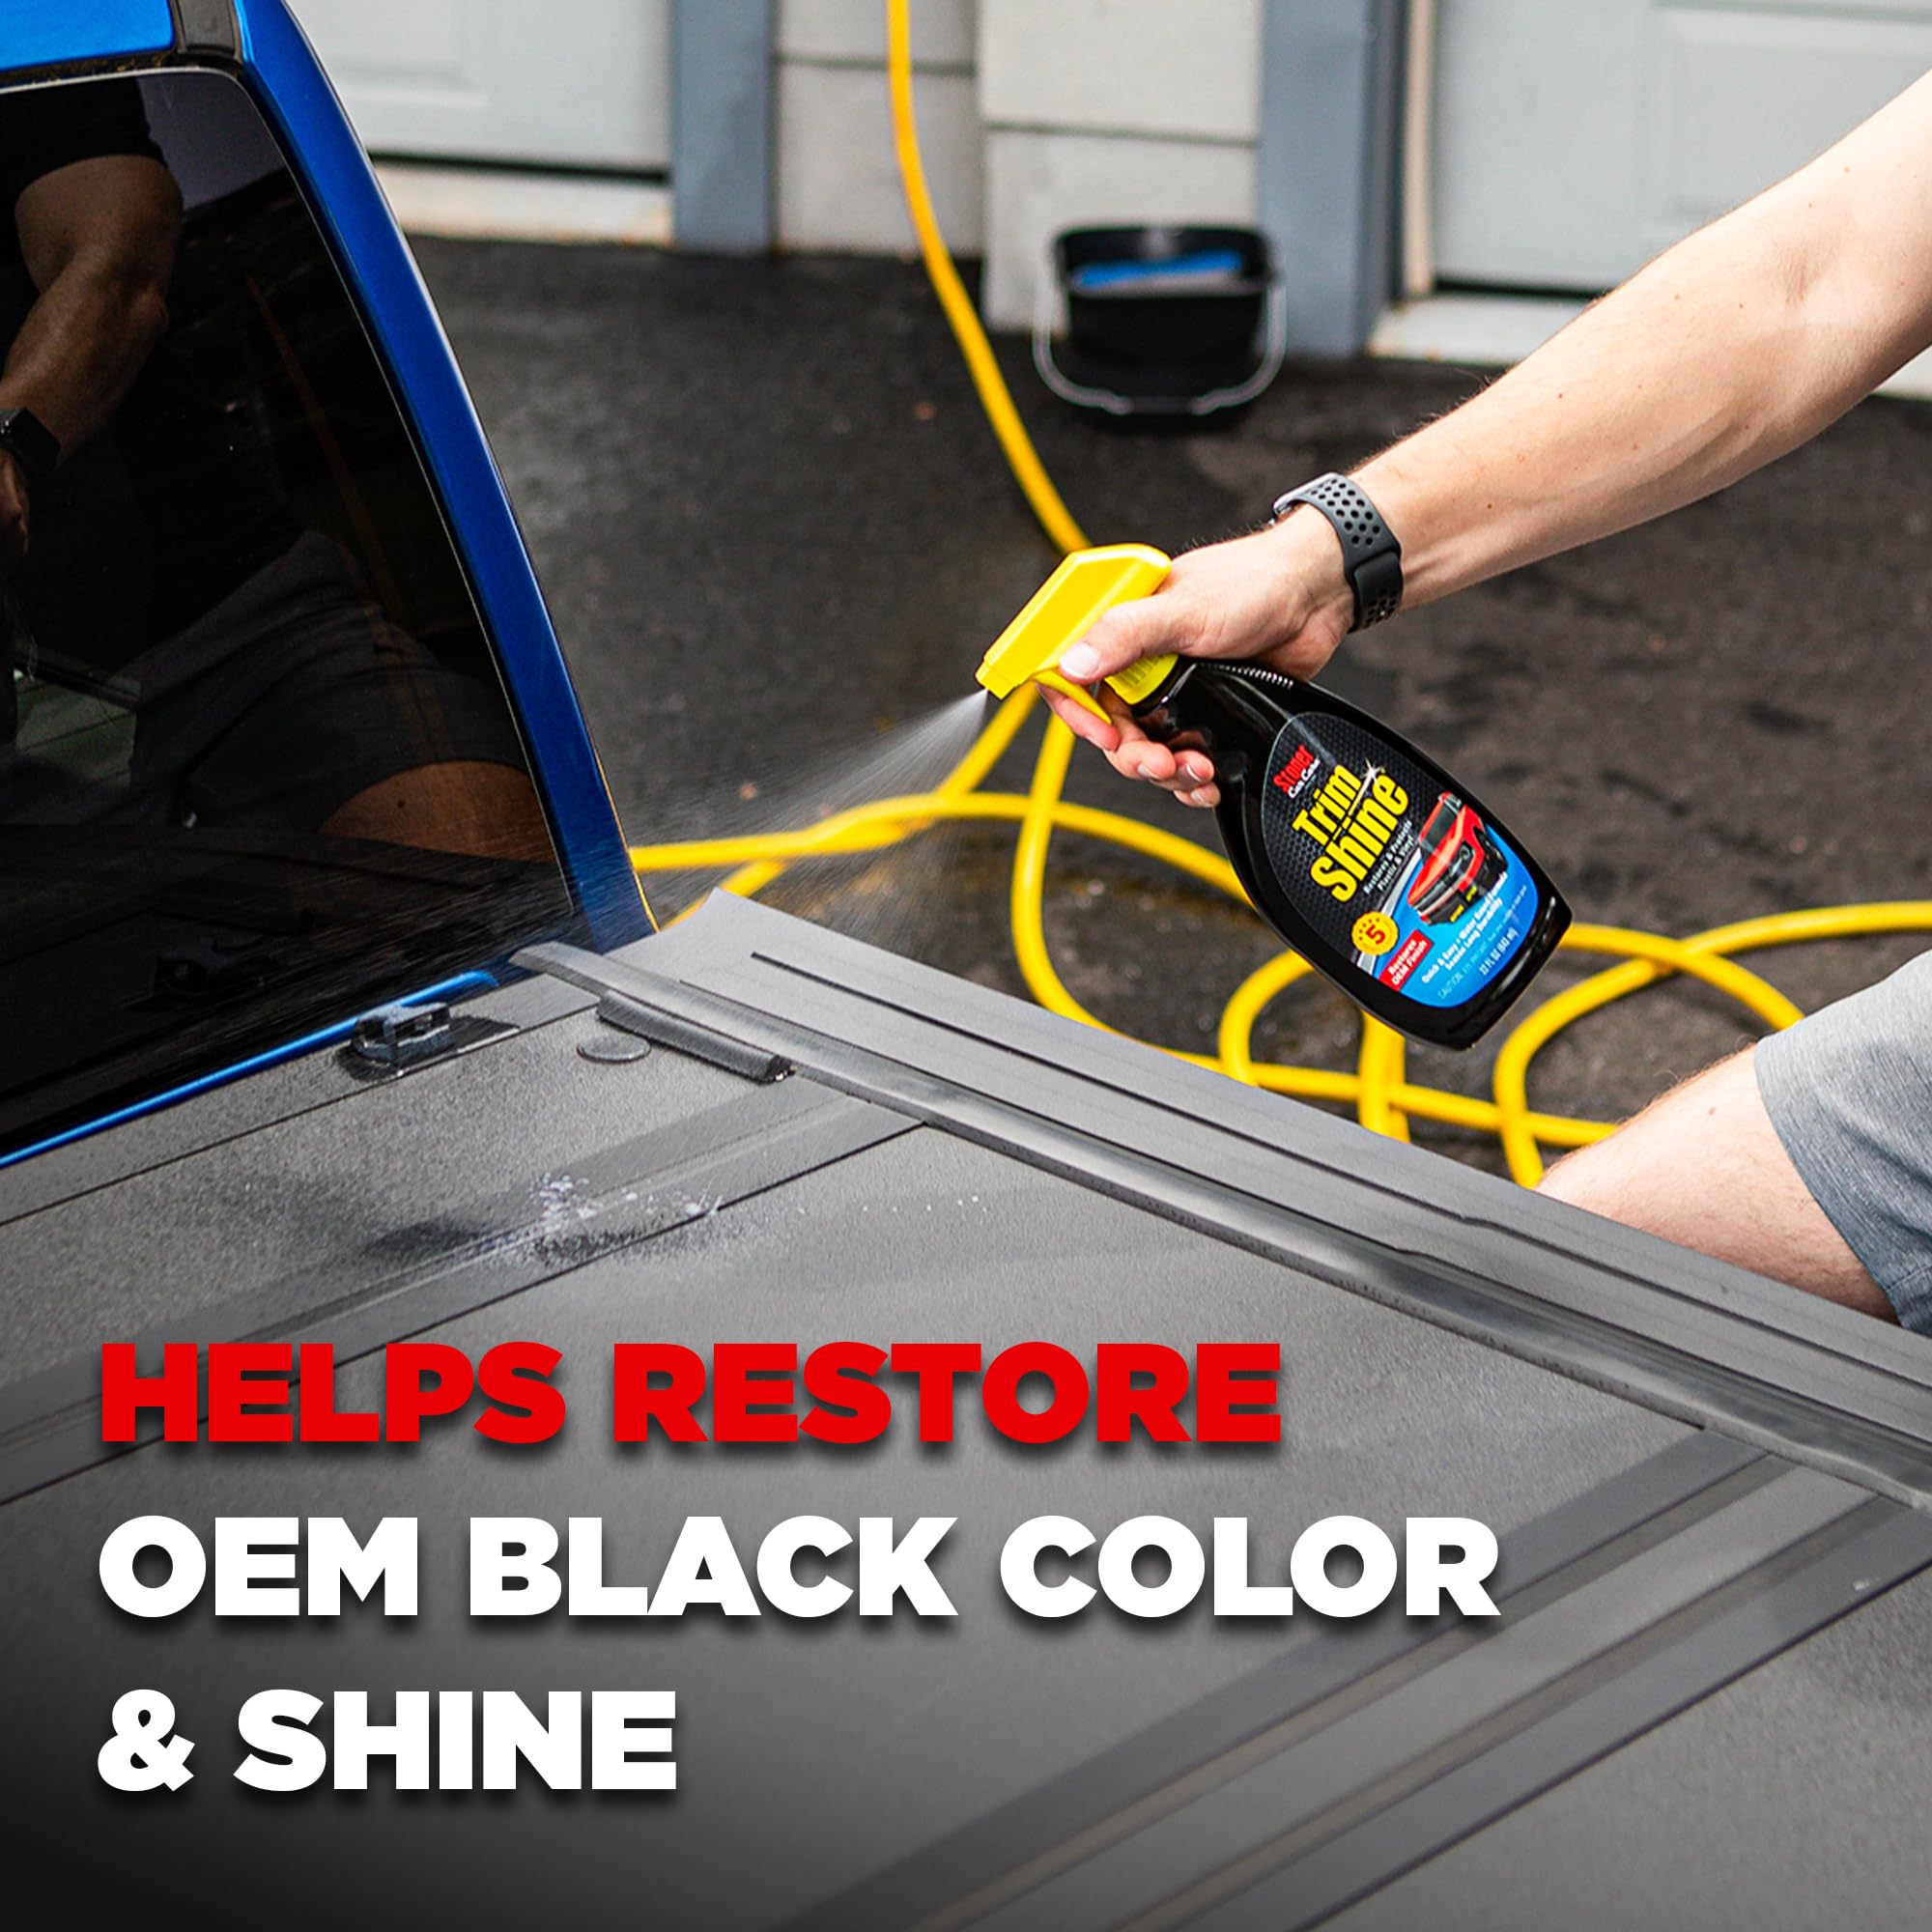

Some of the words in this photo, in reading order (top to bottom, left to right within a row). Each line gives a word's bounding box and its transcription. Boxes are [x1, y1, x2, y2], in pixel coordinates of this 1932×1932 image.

[1291, 763, 1362, 845] Trim
[1310, 775, 1407, 902] Shine
[1365, 923, 1384, 944] 5
